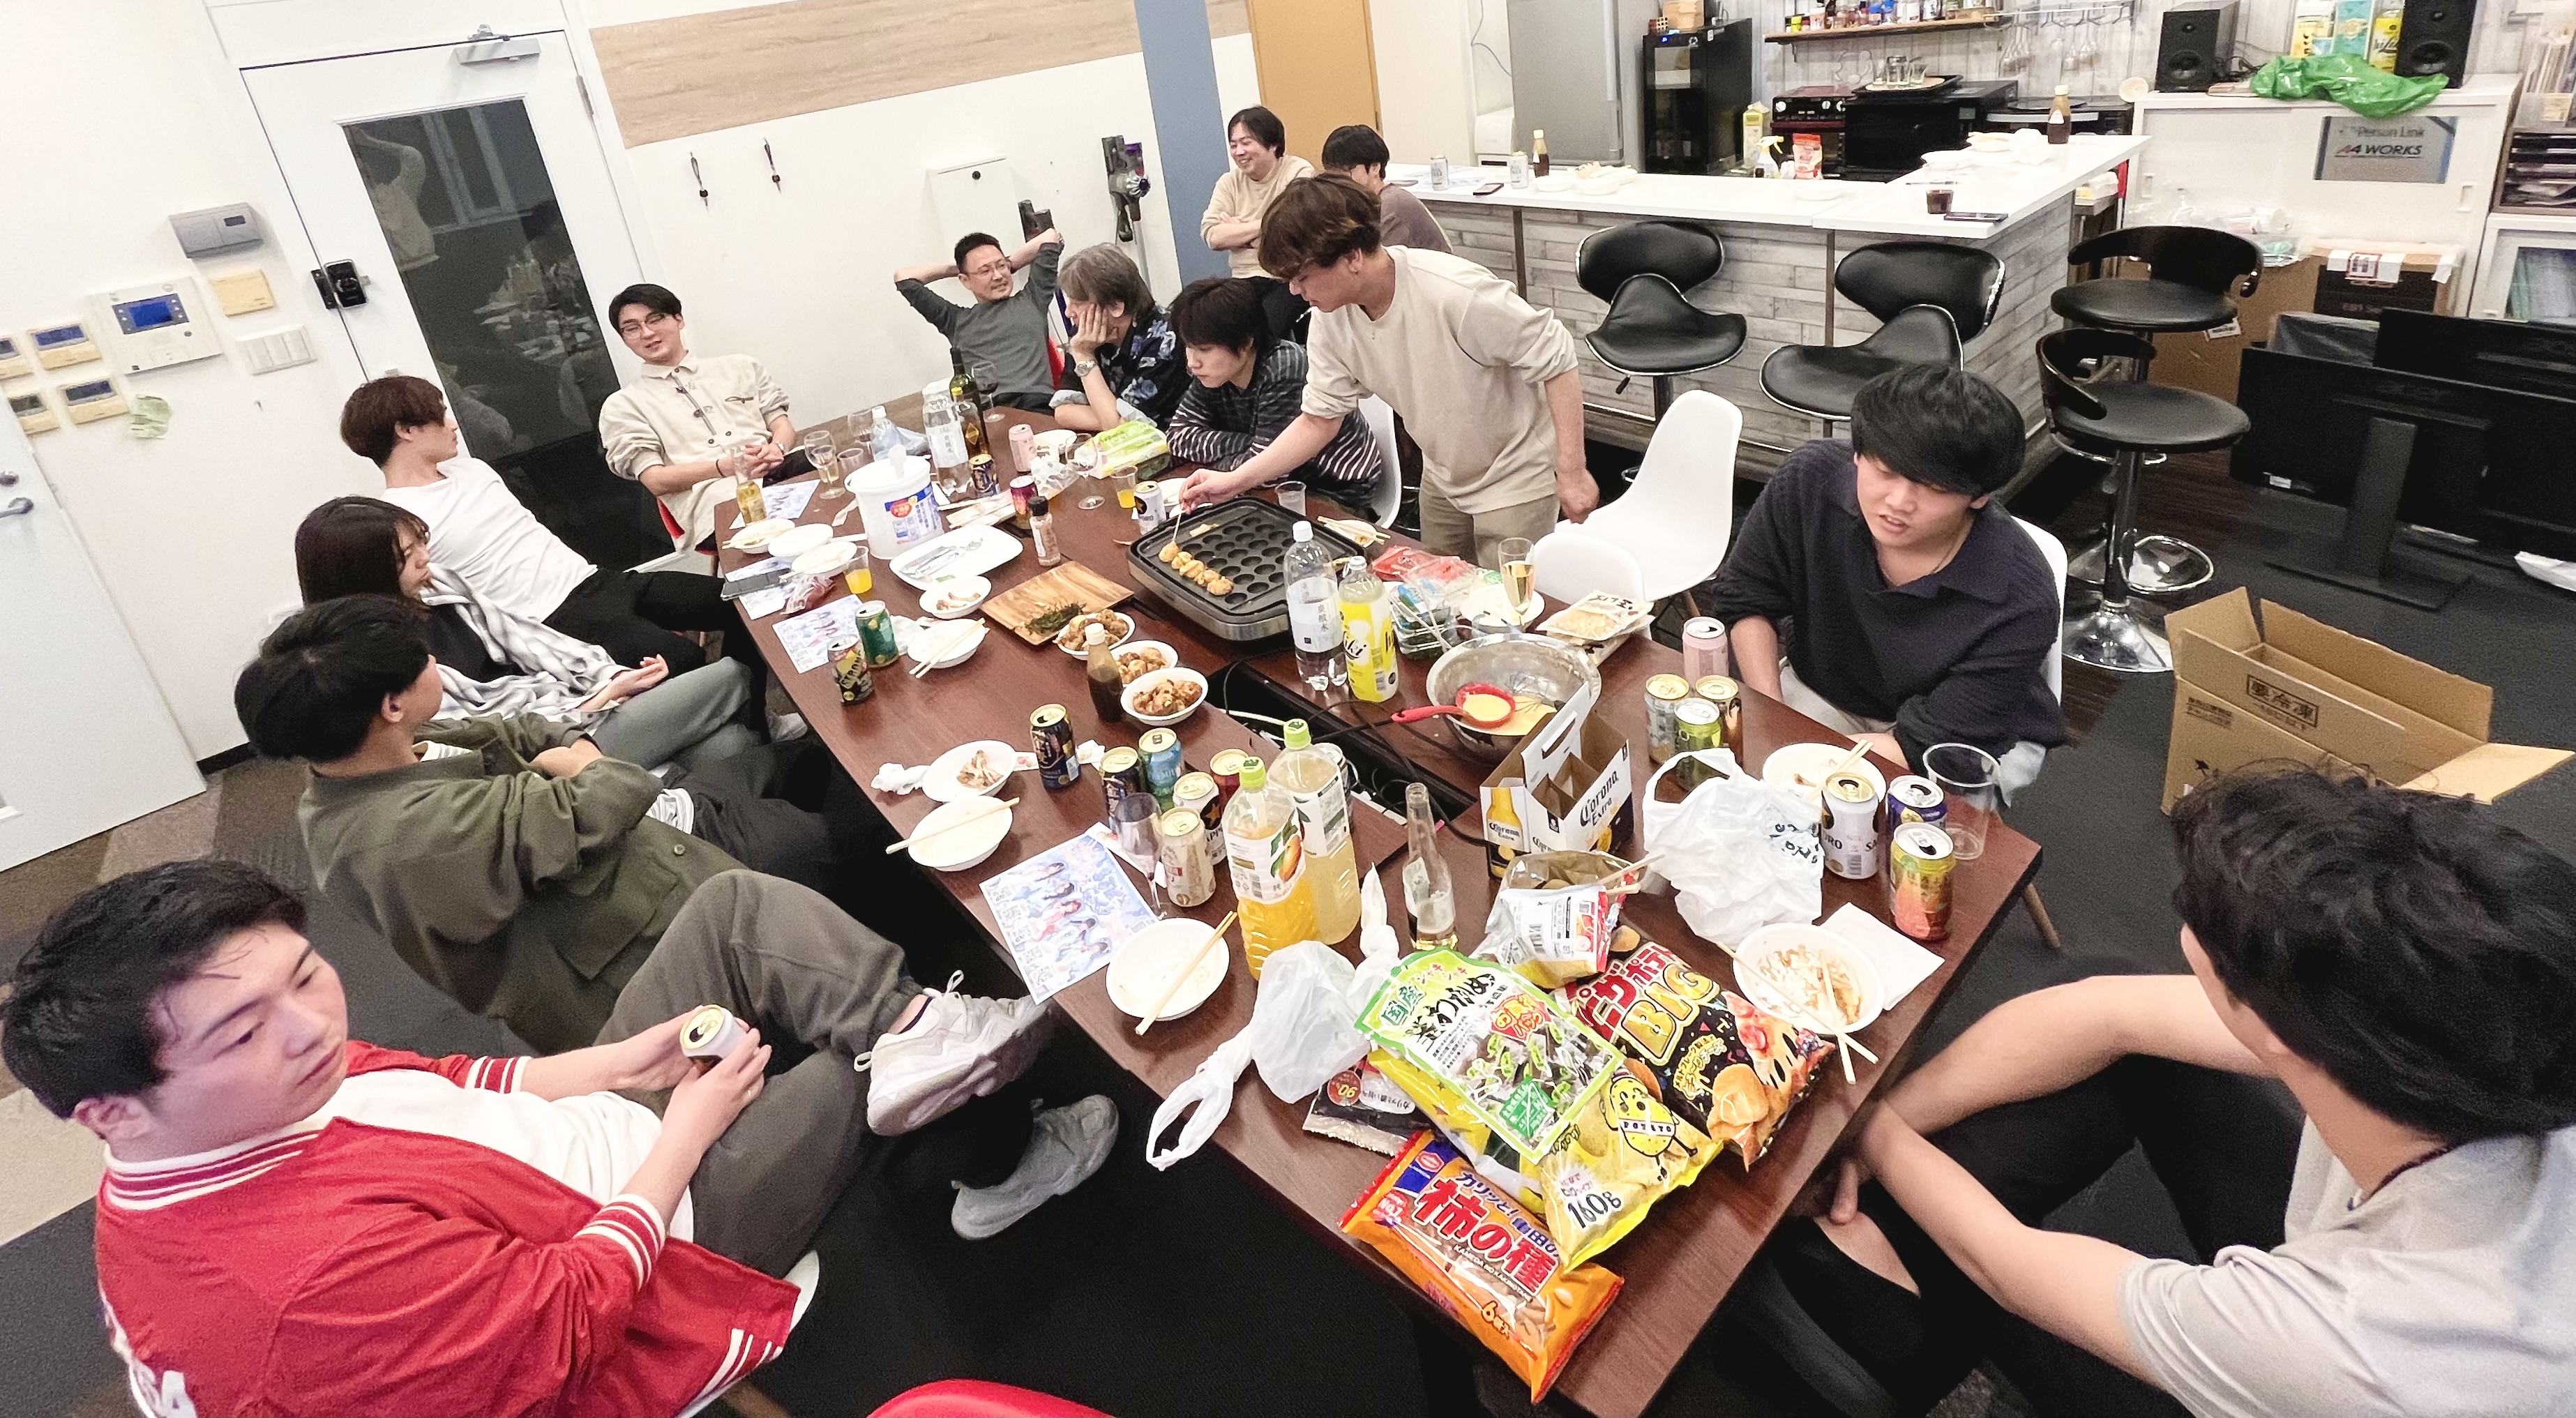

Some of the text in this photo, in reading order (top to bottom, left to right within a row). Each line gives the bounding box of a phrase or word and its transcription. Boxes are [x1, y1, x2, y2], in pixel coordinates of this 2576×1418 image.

[2365, 144, 2423, 155] WORKS
[2250, 679, 2314, 722] 要冷凍
[1580, 770, 1619, 827] Corona
[1592, 797, 1613, 827] Extra
[1489, 822, 1519, 836] Corona
[1380, 982, 1426, 1026] 国産
[1620, 963, 1715, 1063] BIG
[1454, 1171, 1521, 1216] カリッと!
[1567, 1190, 1622, 1229] 160g
[1415, 1177, 1558, 1295] 柿の種
[1453, 1244, 1485, 1270] KAMEDA
